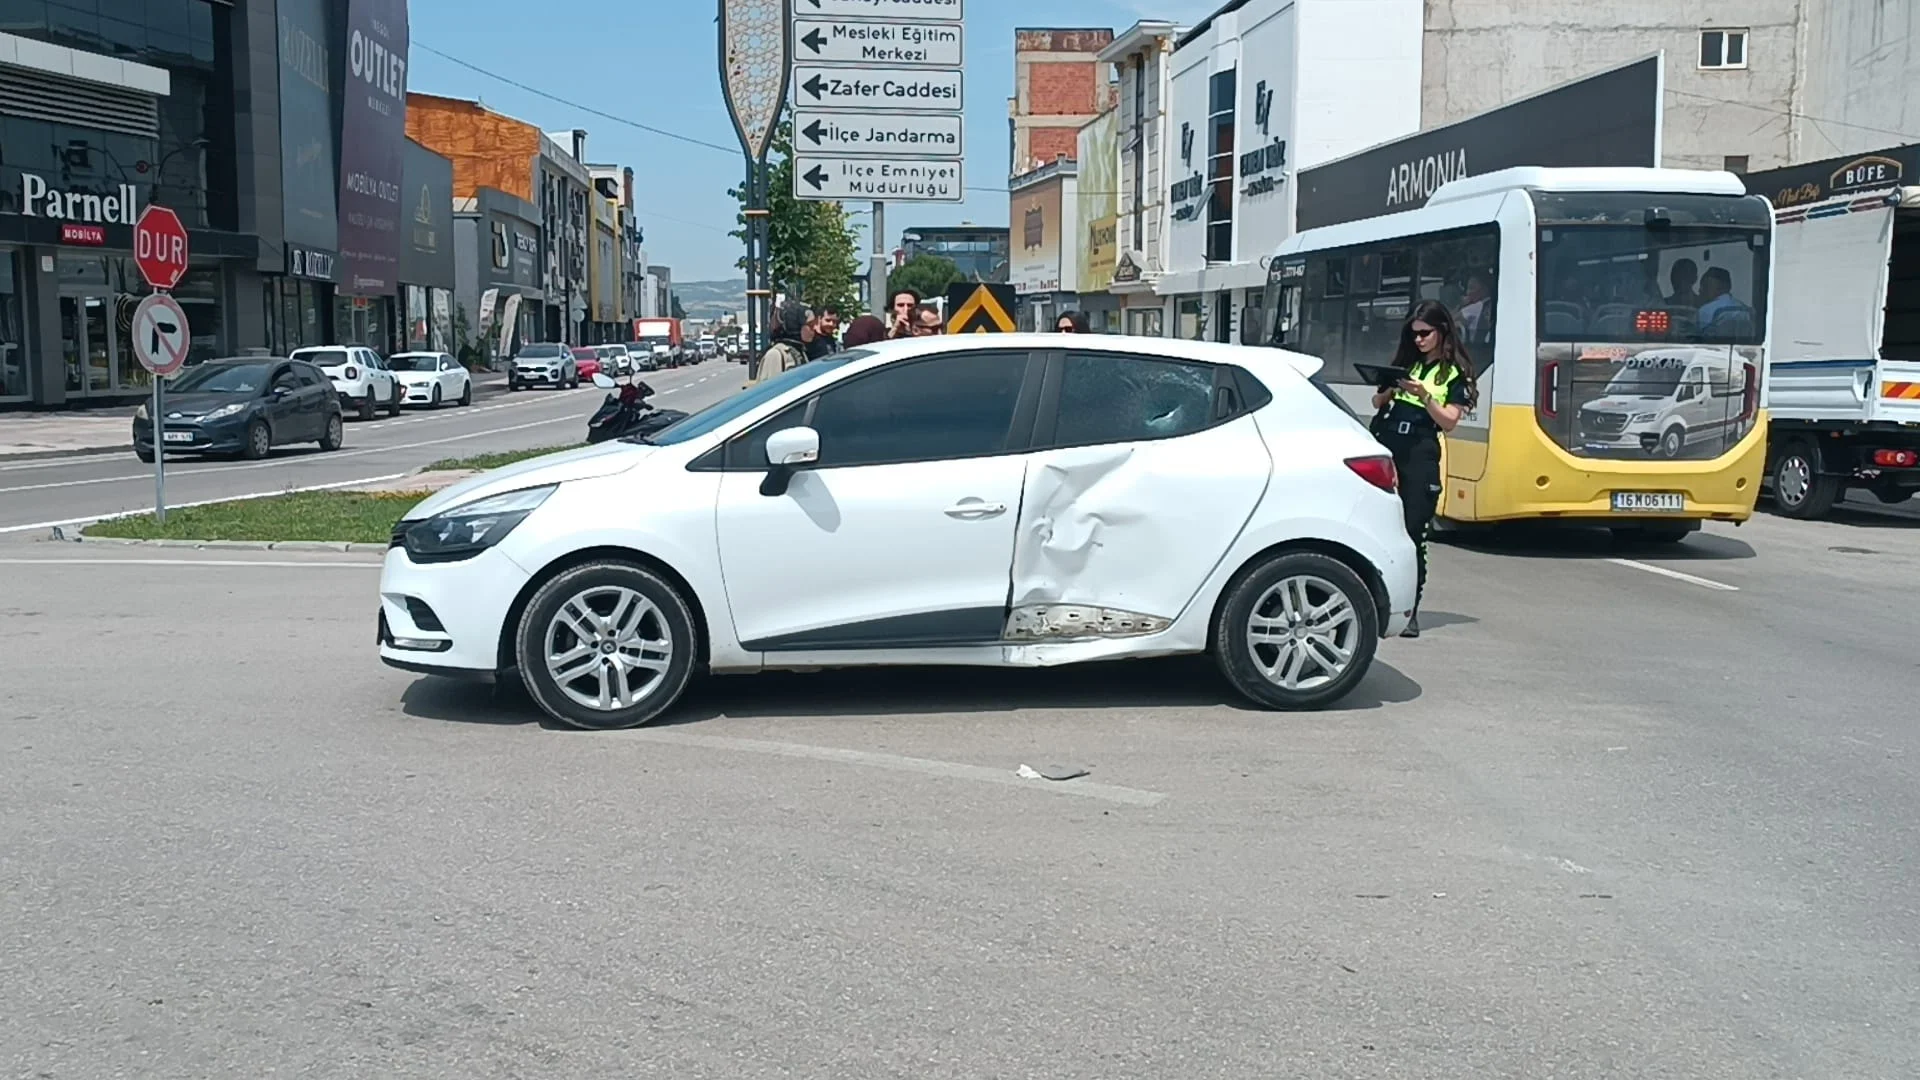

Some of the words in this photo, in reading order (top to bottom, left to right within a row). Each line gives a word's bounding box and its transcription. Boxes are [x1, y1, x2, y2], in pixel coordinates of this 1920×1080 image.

[832, 25, 895, 40] Mesleki
[902, 26, 956, 44] Eğitim
[862, 46, 927, 60] Merkezi
[350, 29, 406, 101] OUTLET
[830, 79, 880, 96] Zafer
[883, 81, 957, 98] Caddesi
[829, 122, 860, 144] İlçe
[865, 128, 956, 144] Jandarma
[842, 160, 875, 177] İlçe
[881, 164, 955, 181] Emniyet
[1386, 147, 1467, 207] ARMONIA
[21, 173, 137, 225] Parnell
[849, 180, 949, 197] Müdürlüğü
[64, 228, 103, 242] MOBİLYA
[139, 228, 184, 265] DUR
